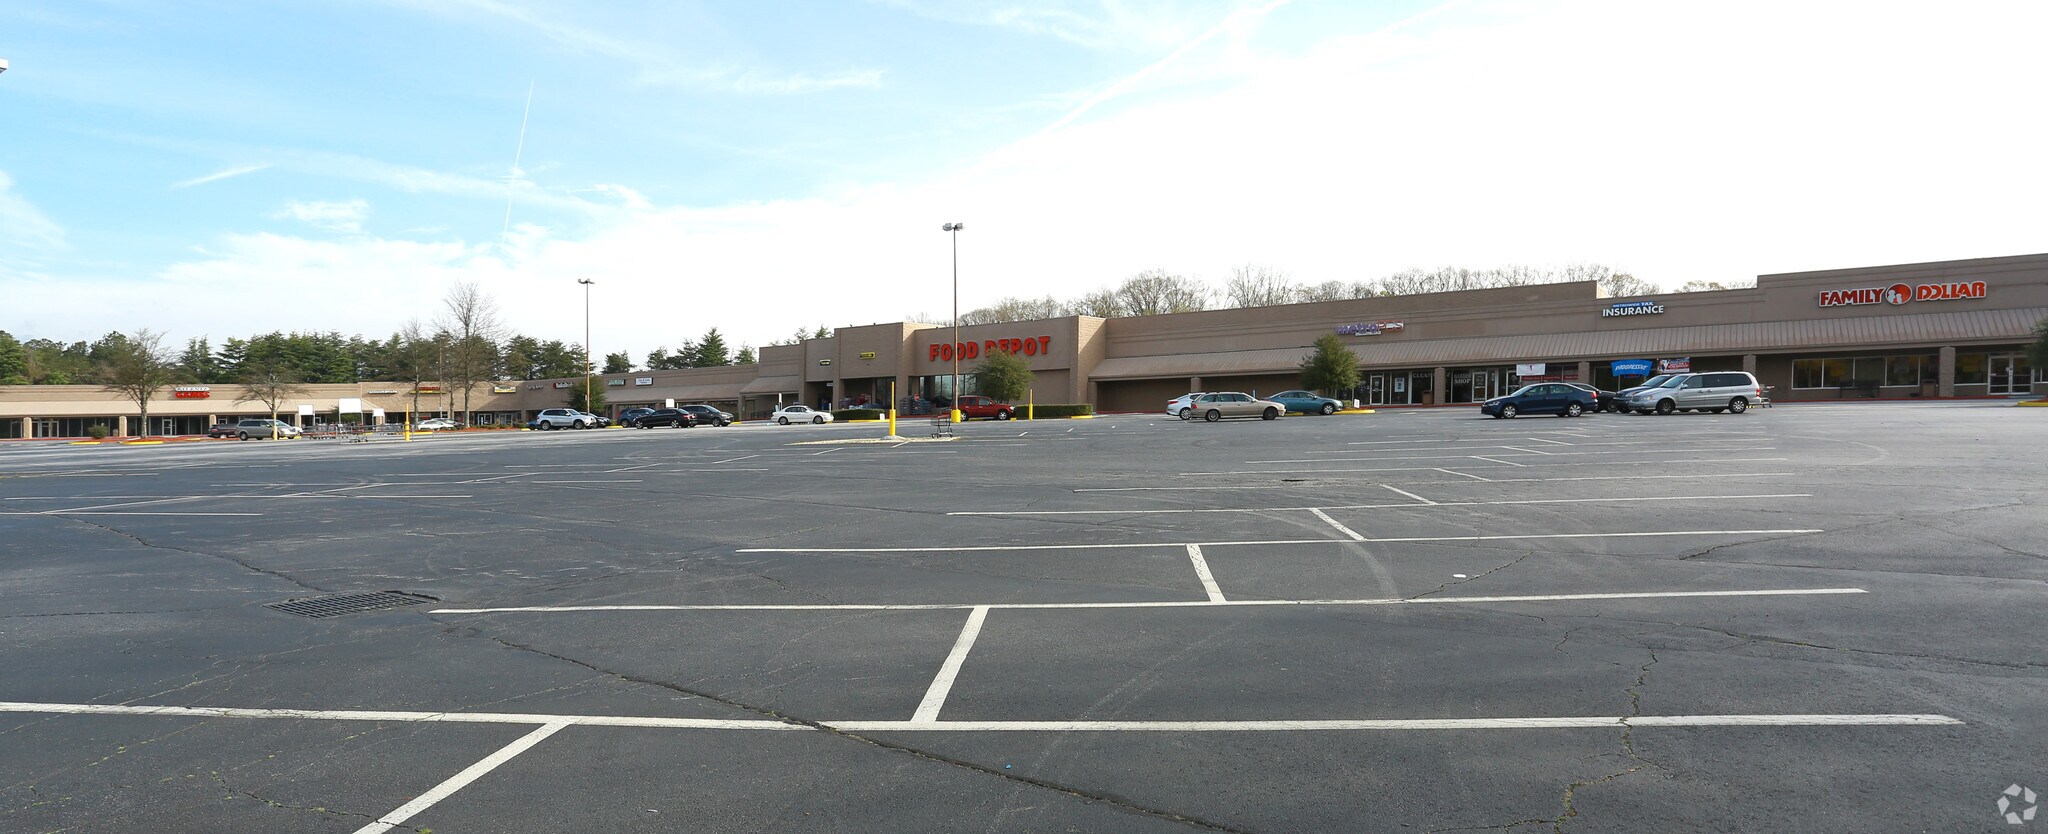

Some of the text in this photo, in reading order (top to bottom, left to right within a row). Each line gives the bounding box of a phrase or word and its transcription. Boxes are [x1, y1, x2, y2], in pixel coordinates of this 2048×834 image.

[1819, 281, 1987, 308] FAMILY DOLLAR
[1602, 305, 1664, 317] INSURANCE
[929, 335, 1051, 361] FOOD DEPOT
[1615, 363, 1648, 372] PROGRESSIVE
